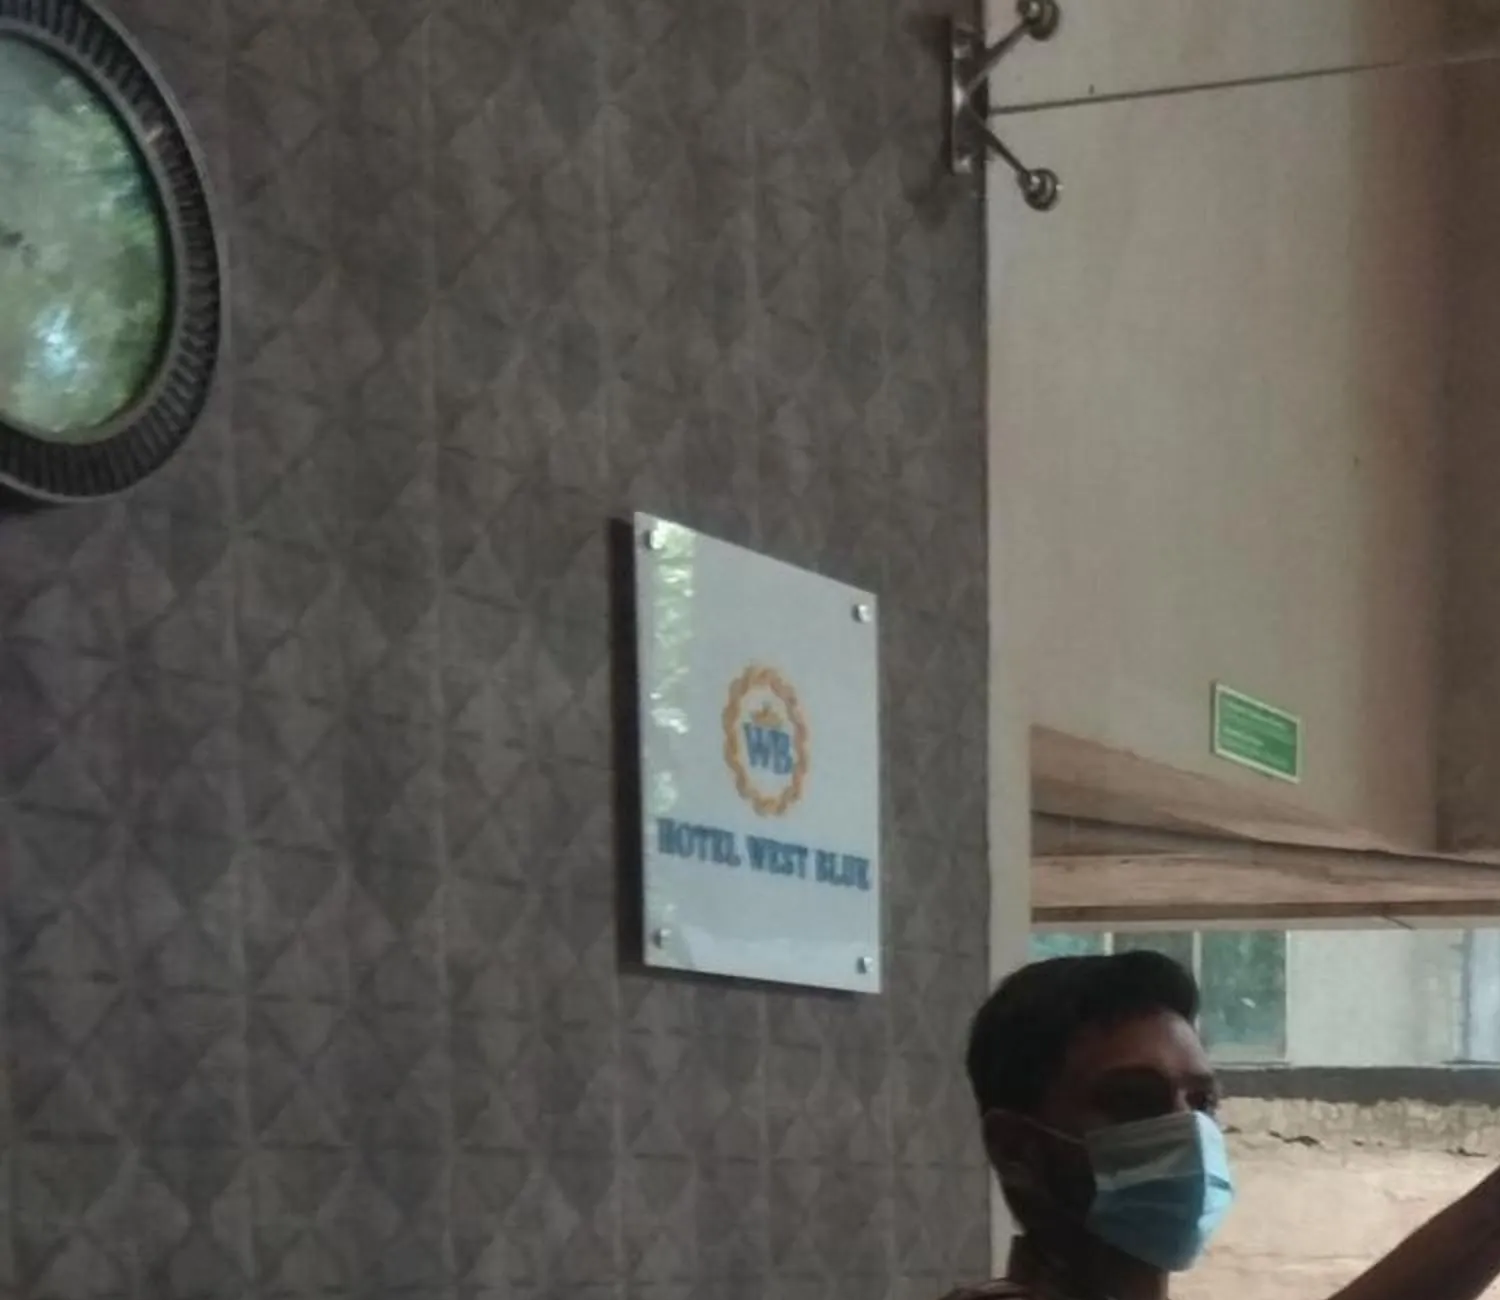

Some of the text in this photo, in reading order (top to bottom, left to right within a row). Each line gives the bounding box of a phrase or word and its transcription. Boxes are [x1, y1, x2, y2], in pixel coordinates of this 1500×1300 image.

[743, 721, 793, 775] WB
[656, 817, 870, 891] HOTEL WEST BLUE
